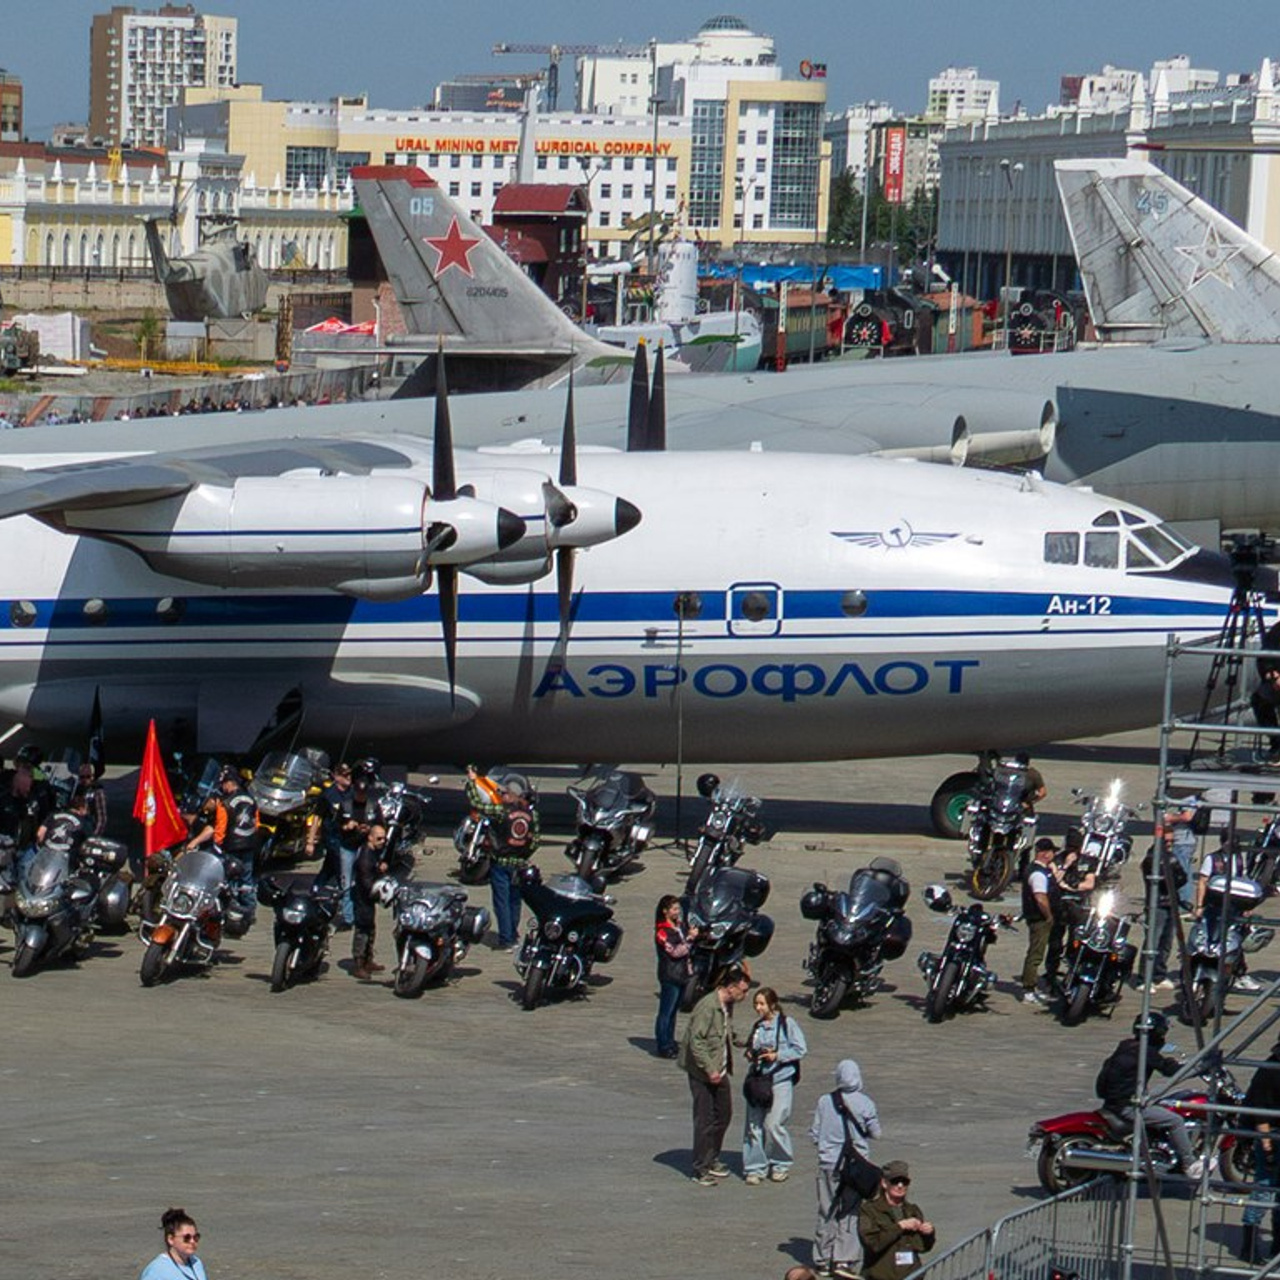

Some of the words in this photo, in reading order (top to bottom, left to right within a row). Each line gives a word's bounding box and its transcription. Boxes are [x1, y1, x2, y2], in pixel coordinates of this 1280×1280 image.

[395, 138, 431, 152] URAL
[435, 139, 485, 153] MINING
[489, 140, 600, 155] METLURGICAL
[603, 141, 672, 156] COMPANY
[409, 197, 435, 217] 05
[1046, 595, 1111, 615] Ан-12
[534, 659, 980, 702] АЭРОФЛОТ
